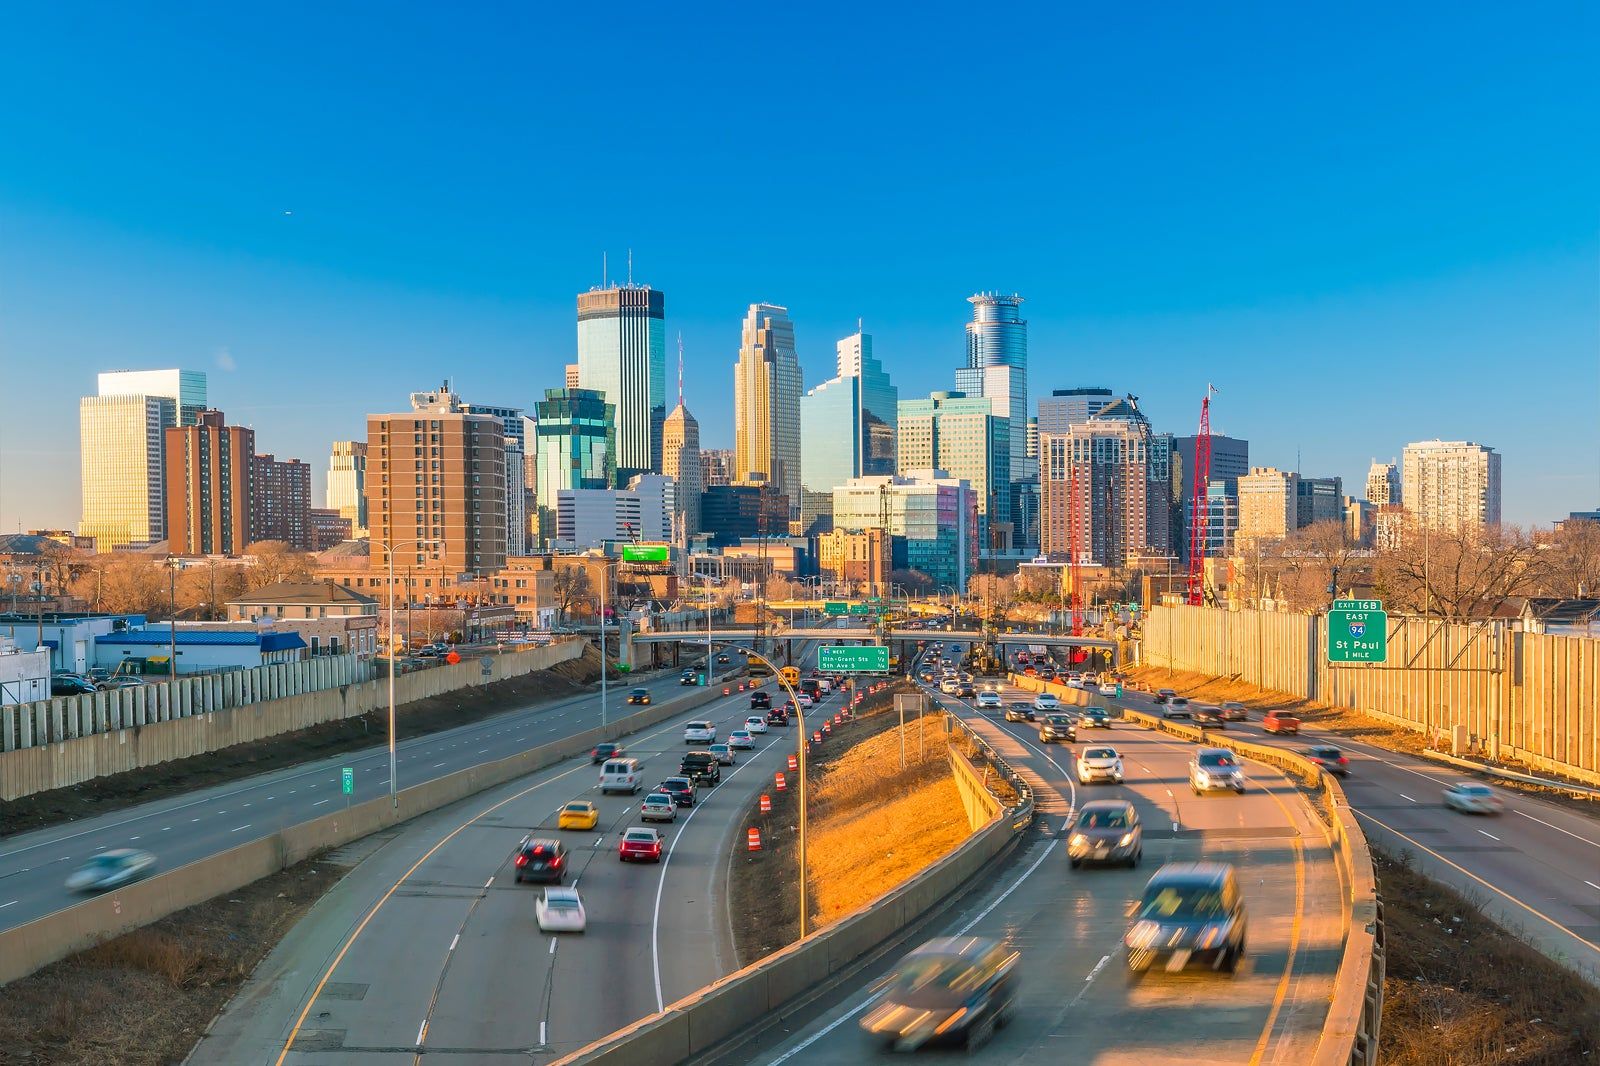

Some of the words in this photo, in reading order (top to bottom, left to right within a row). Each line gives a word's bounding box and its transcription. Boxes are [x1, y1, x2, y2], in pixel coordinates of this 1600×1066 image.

[1358, 602, 1377, 610] 16B
[1336, 640, 1348, 648] St
[1354, 640, 1379, 650] Paul
